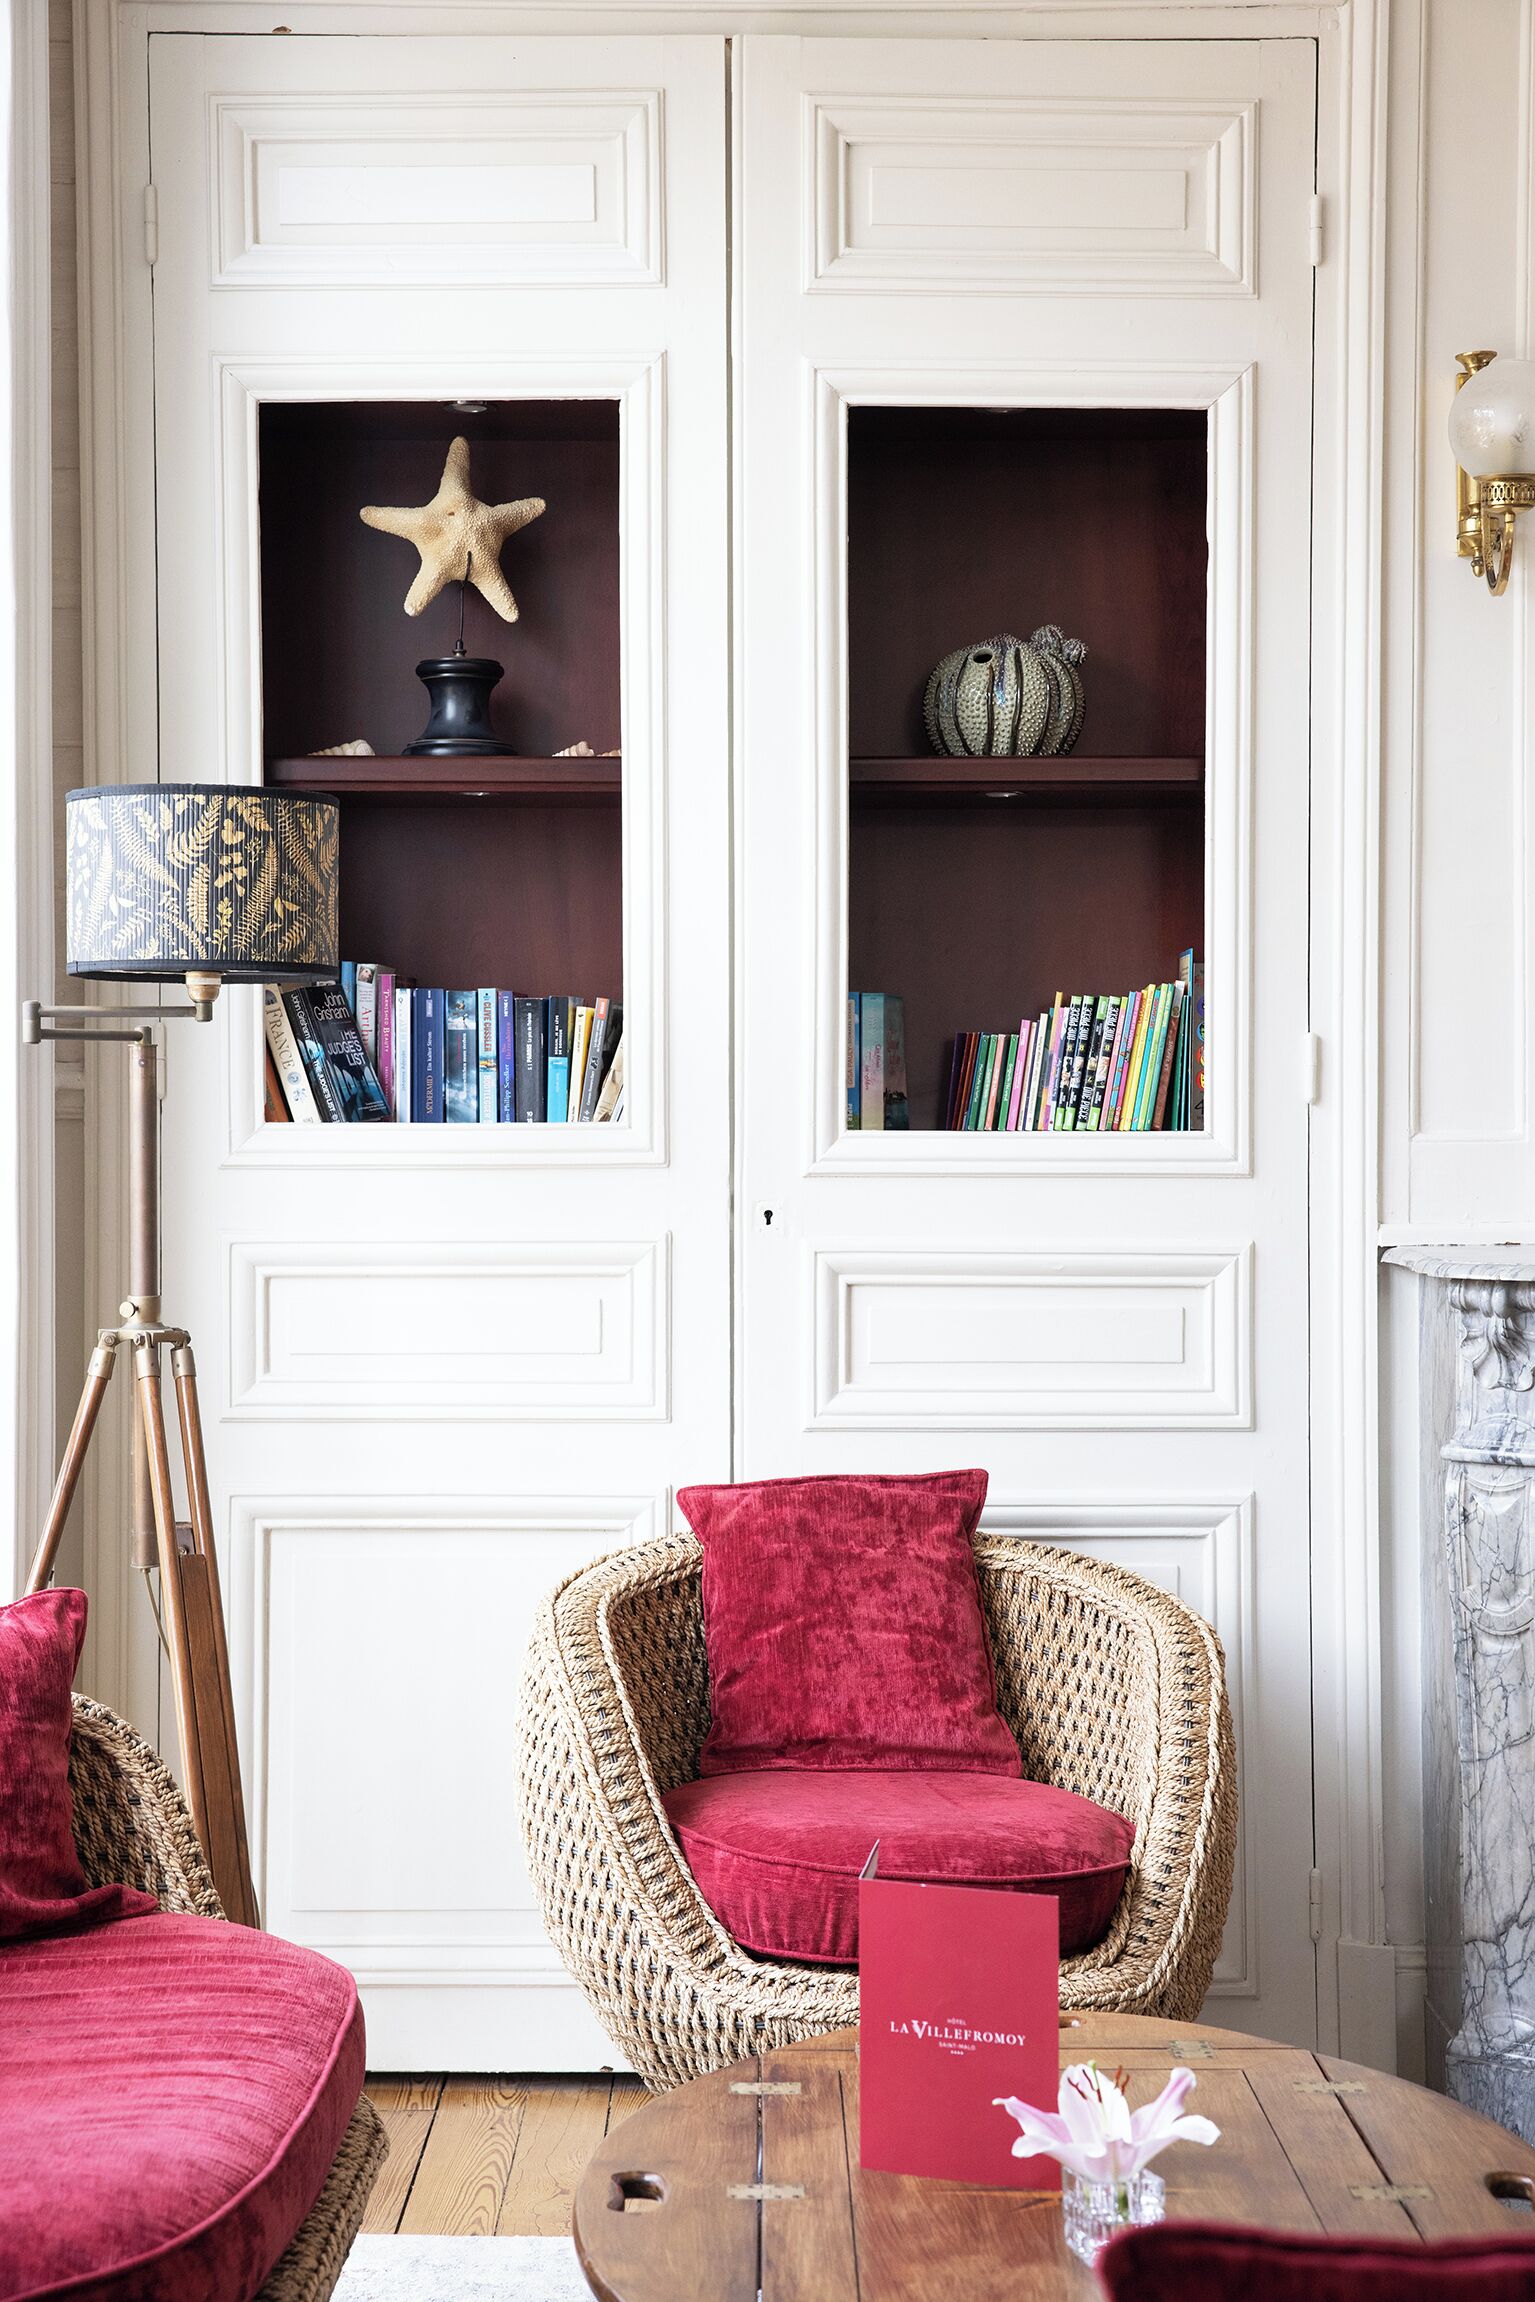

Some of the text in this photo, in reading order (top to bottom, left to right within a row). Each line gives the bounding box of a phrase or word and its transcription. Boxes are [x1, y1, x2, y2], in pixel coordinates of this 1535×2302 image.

[324, 992, 345, 1007] John
[291, 993, 311, 1041] John Grisham
[313, 1005, 350, 1021] Grisham
[1067, 1007, 1081, 1041] ONE PIECE
[1079, 1007, 1093, 1041] ONE PIECE
[1106, 1007, 1119, 1028] PIECE
[265, 1007, 295, 1070] FRANCE
[340, 1029, 358, 1041] THE
[483, 1001, 492, 1052] CLIVE CUSSLER
[1104, 1027, 1116, 1041] ONE
[327, 1039, 362, 1056] JUDGE'S
[382, 1028, 391, 1053] BEAUTY
[345, 1051, 366, 1066] LIST
[312, 1059, 322, 1075] THE
[326, 1097, 337, 1112] LIST
[503, 1089, 511, 1122] an-Philipp
[1078, 1086, 1093, 1121] ONE PIECE
[890, 2019, 1026, 2046] LA VILLEFROMOY
[947, 2017, 967, 2026] HÔTEL
[938, 2041, 976, 2051] SAINT-MALO
